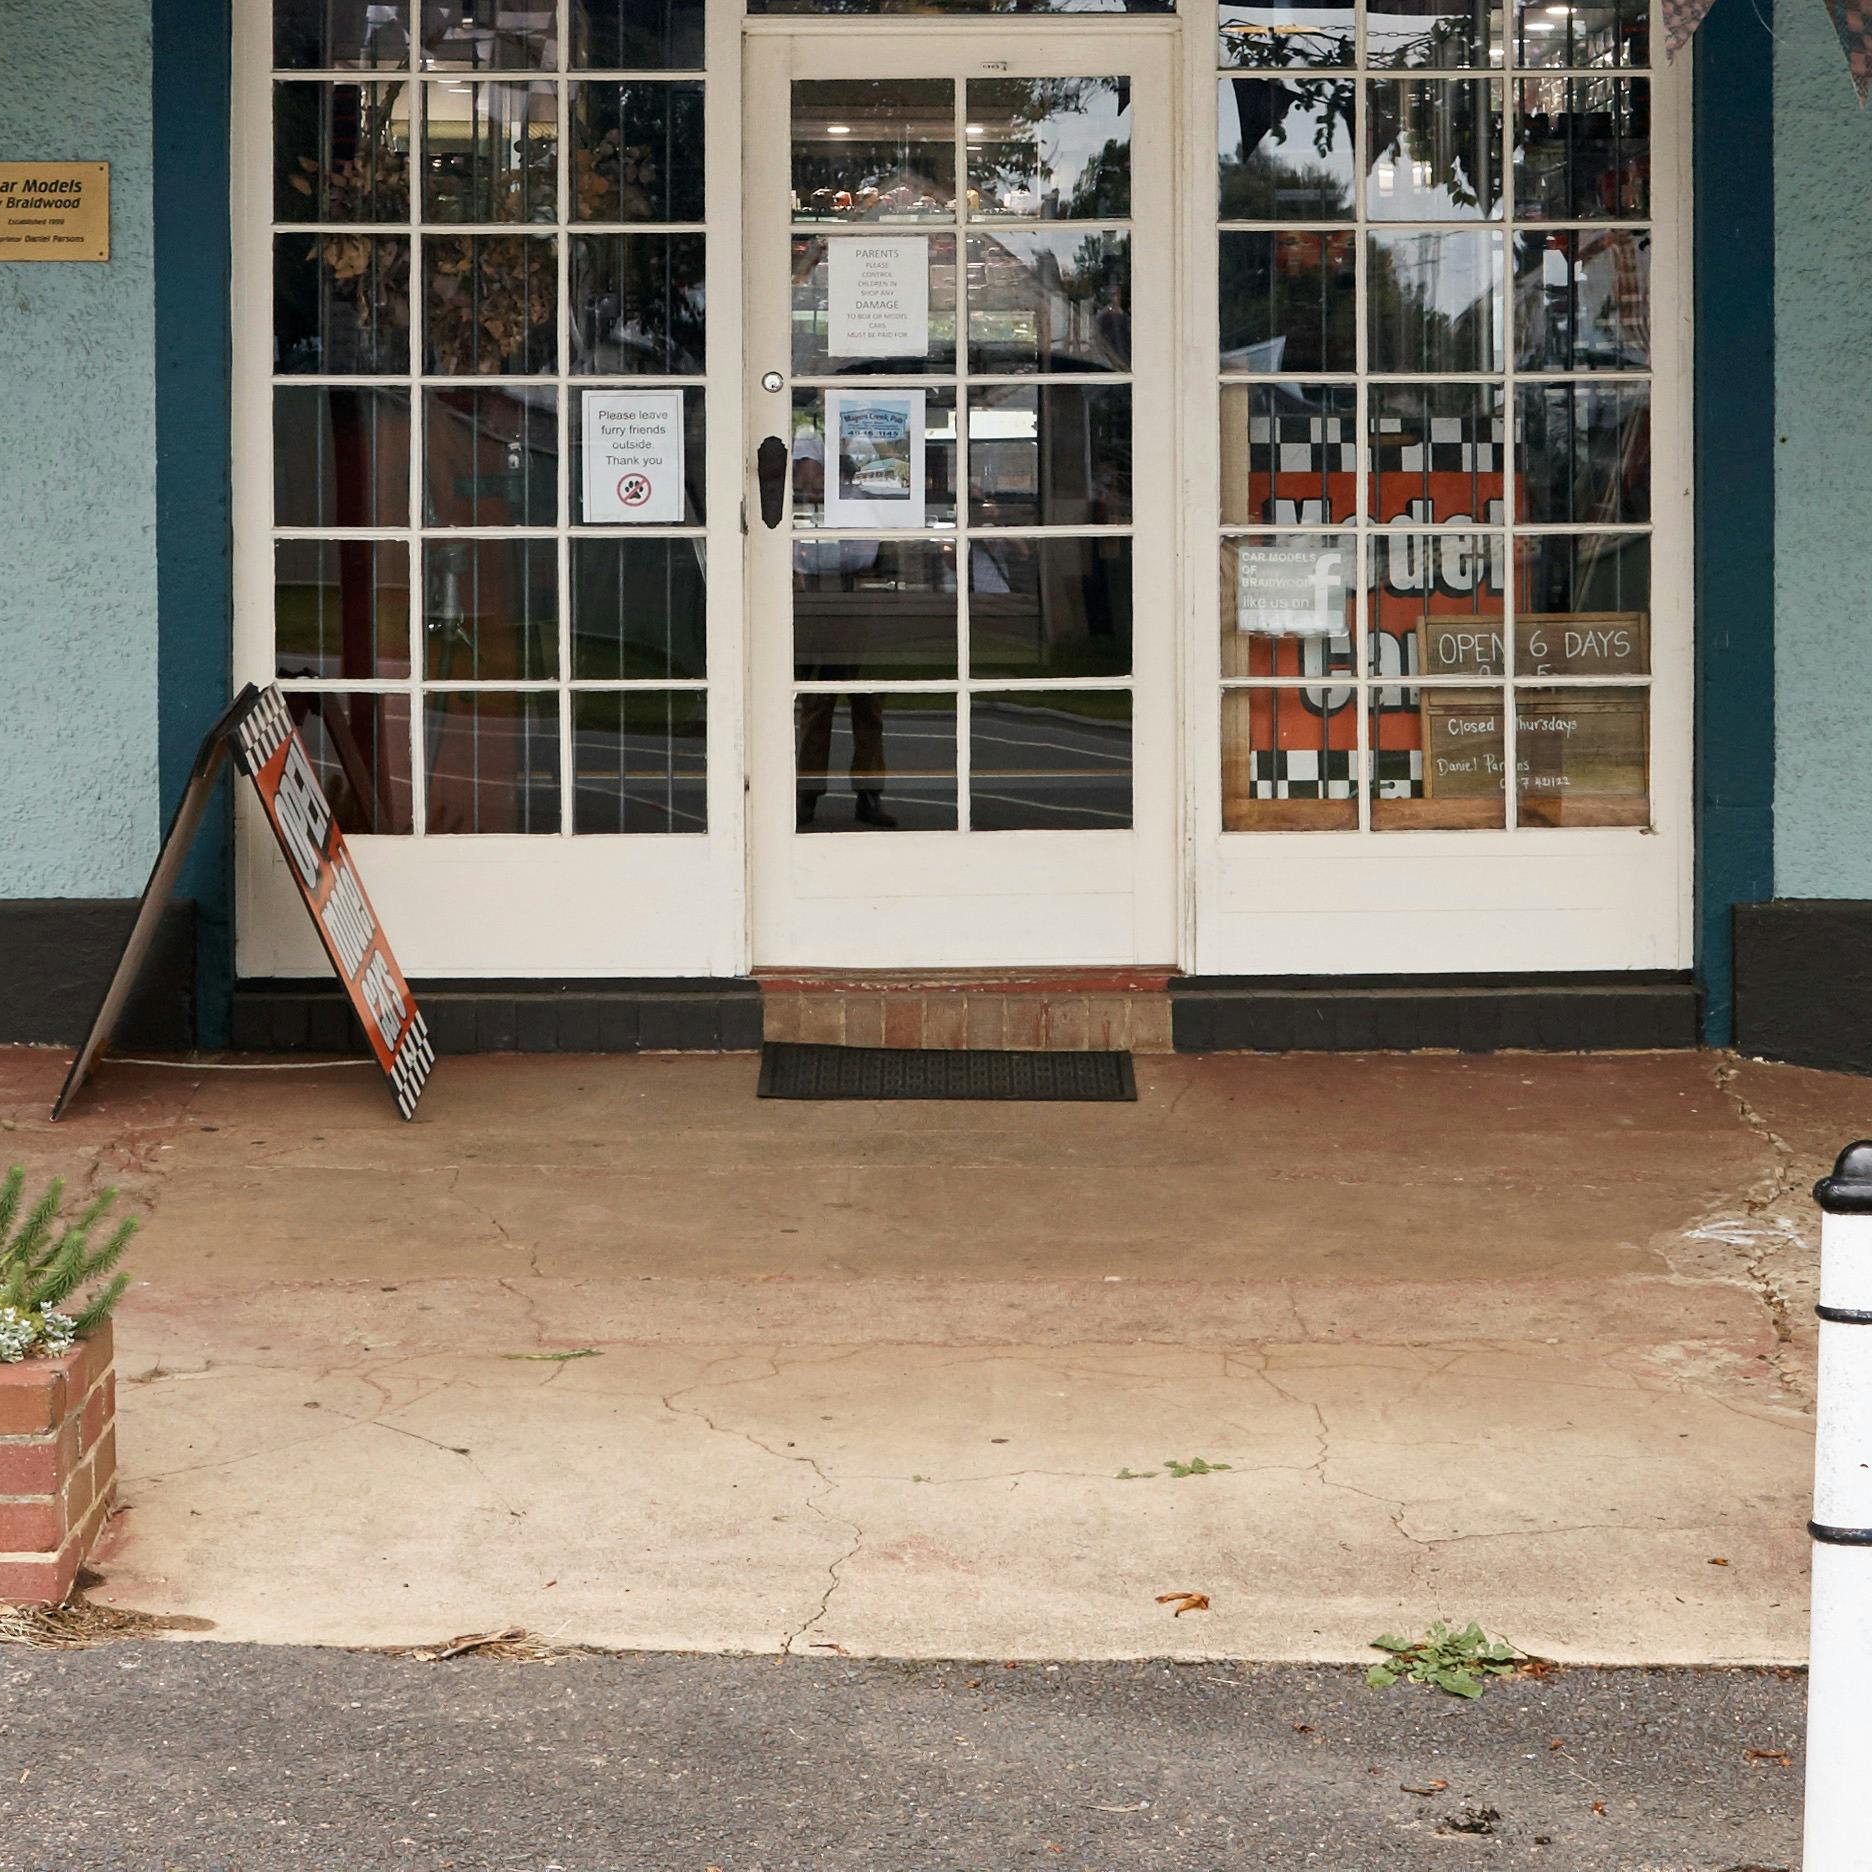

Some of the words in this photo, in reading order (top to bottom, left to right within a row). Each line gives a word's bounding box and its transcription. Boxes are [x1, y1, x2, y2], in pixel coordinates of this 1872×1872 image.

[22, 179, 82, 193] Models
[6, 197, 81, 209] Braidwood
[855, 249, 900, 259] PARENTS
[855, 300, 899, 310] DAMAGE
[846, 331, 866, 339] MUST
[598, 410, 636, 421] Please
[639, 410, 668, 420] leave
[601, 425, 627, 437] furry
[629, 425, 666, 435] friends
[606, 455, 640, 465] Thank
[642, 457, 663, 467] you
[1241, 552, 1267, 562] CAR
[1268, 552, 1317, 563] MODELS
[1241, 565, 1257, 574] OF
[1243, 596, 1266, 608] like
[1270, 598, 1288, 608] us
[1291, 598, 1310, 608] on
[1439, 632, 1505, 664] OPEN
[1529, 630, 1548, 657] 6
[1565, 630, 1631, 659] DAYS
[1448, 717, 1495, 735] Closed
[1436, 757, 1477, 776] Daniel
[274, 732, 331, 889] OPEN
